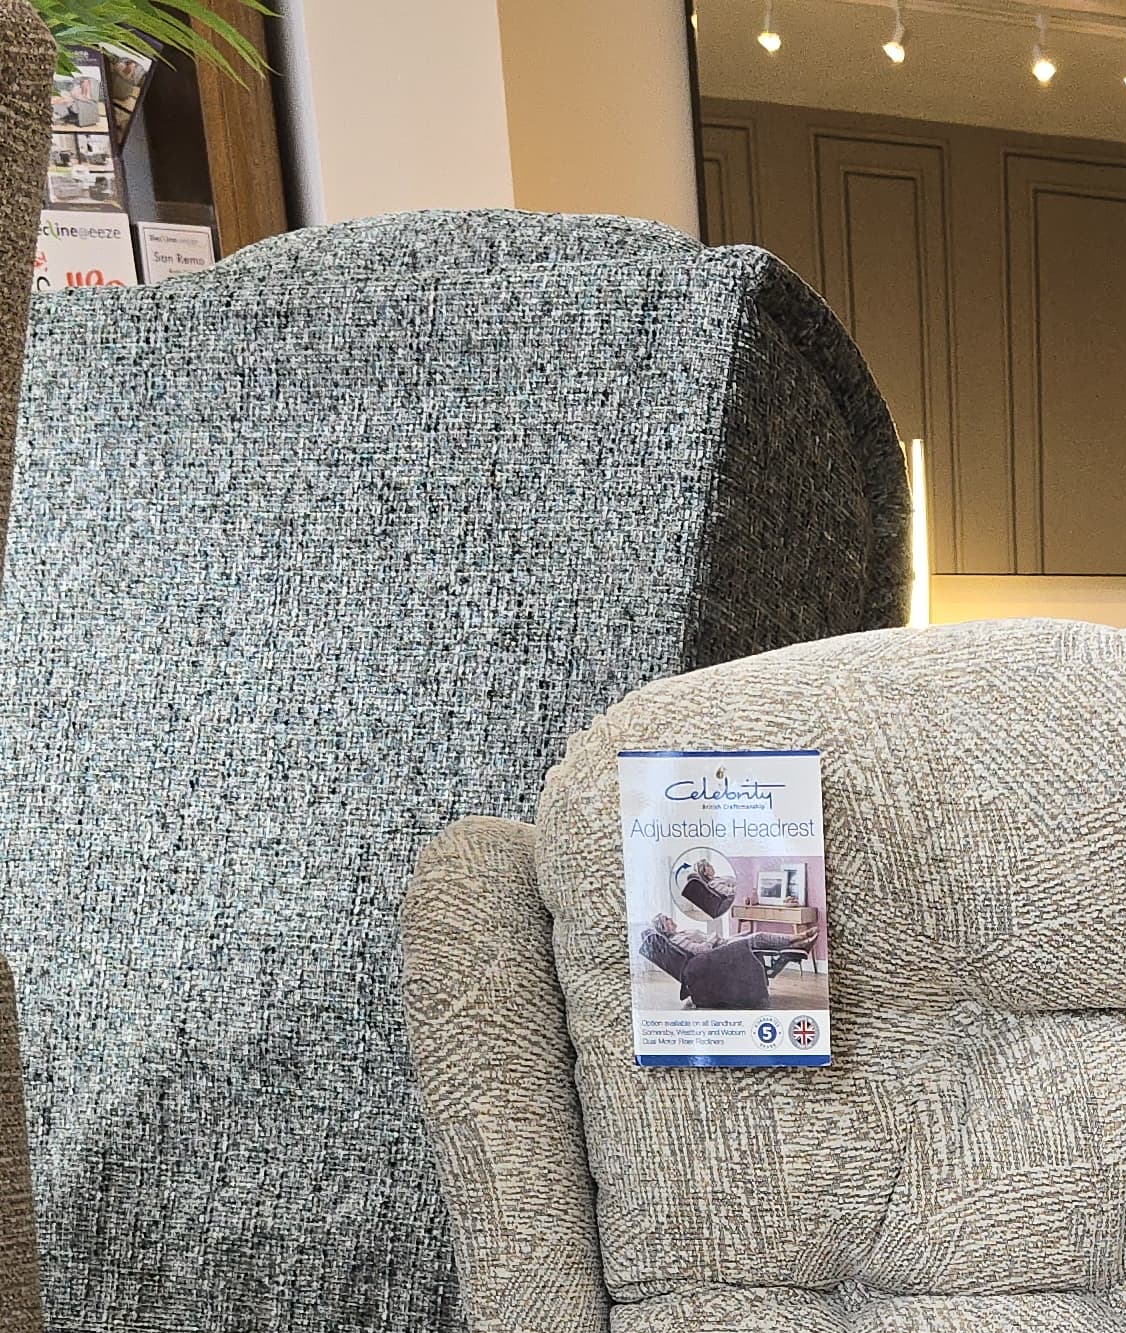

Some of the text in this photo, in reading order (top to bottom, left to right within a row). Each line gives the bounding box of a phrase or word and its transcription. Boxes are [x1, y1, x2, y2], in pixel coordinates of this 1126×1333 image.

[36, 218, 121, 241] ecline@eeze
[664, 776, 786, 809] Celebrity
[630, 818, 816, 842] Adjustable Headrest
[762, 1026, 773, 1041] 5
